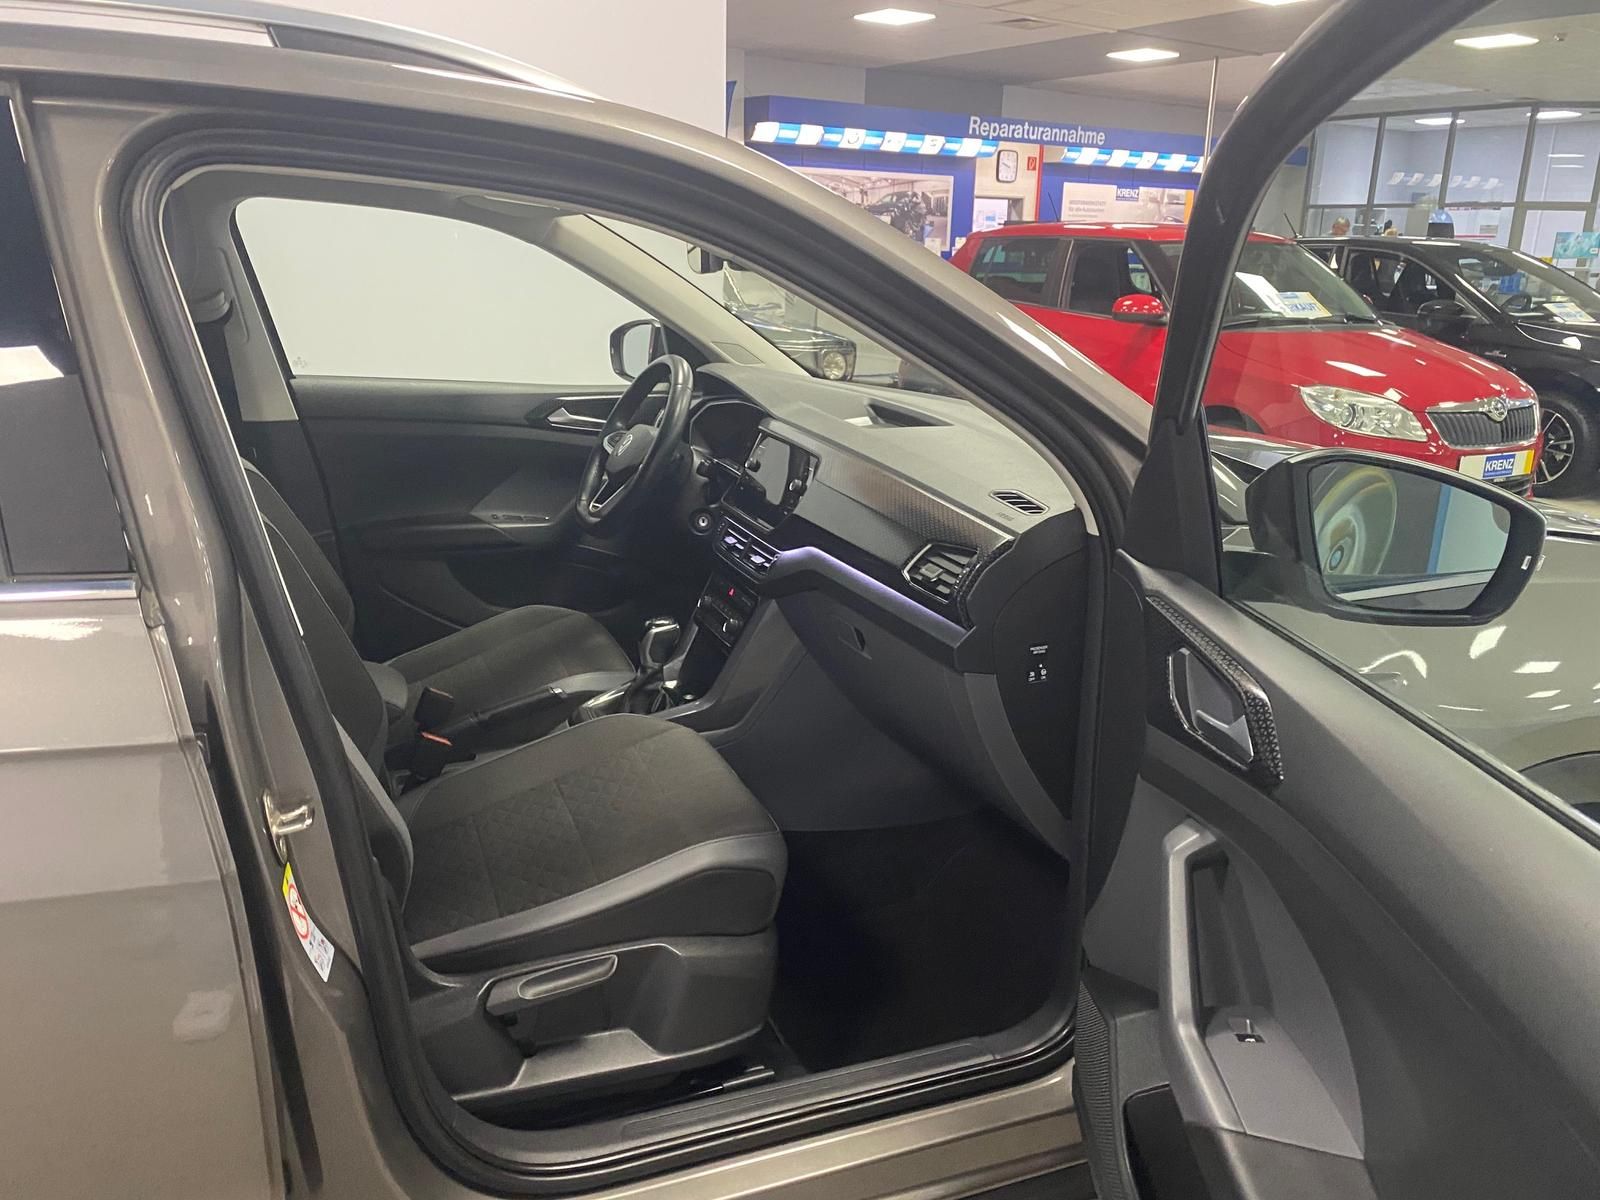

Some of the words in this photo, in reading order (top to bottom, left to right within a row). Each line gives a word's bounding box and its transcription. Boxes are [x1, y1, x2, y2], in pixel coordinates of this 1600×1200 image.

[969, 116, 1105, 144] Reparaturannahme
[1117, 188, 1139, 198] KRENZ
[1485, 458, 1515, 472] KRENZ
